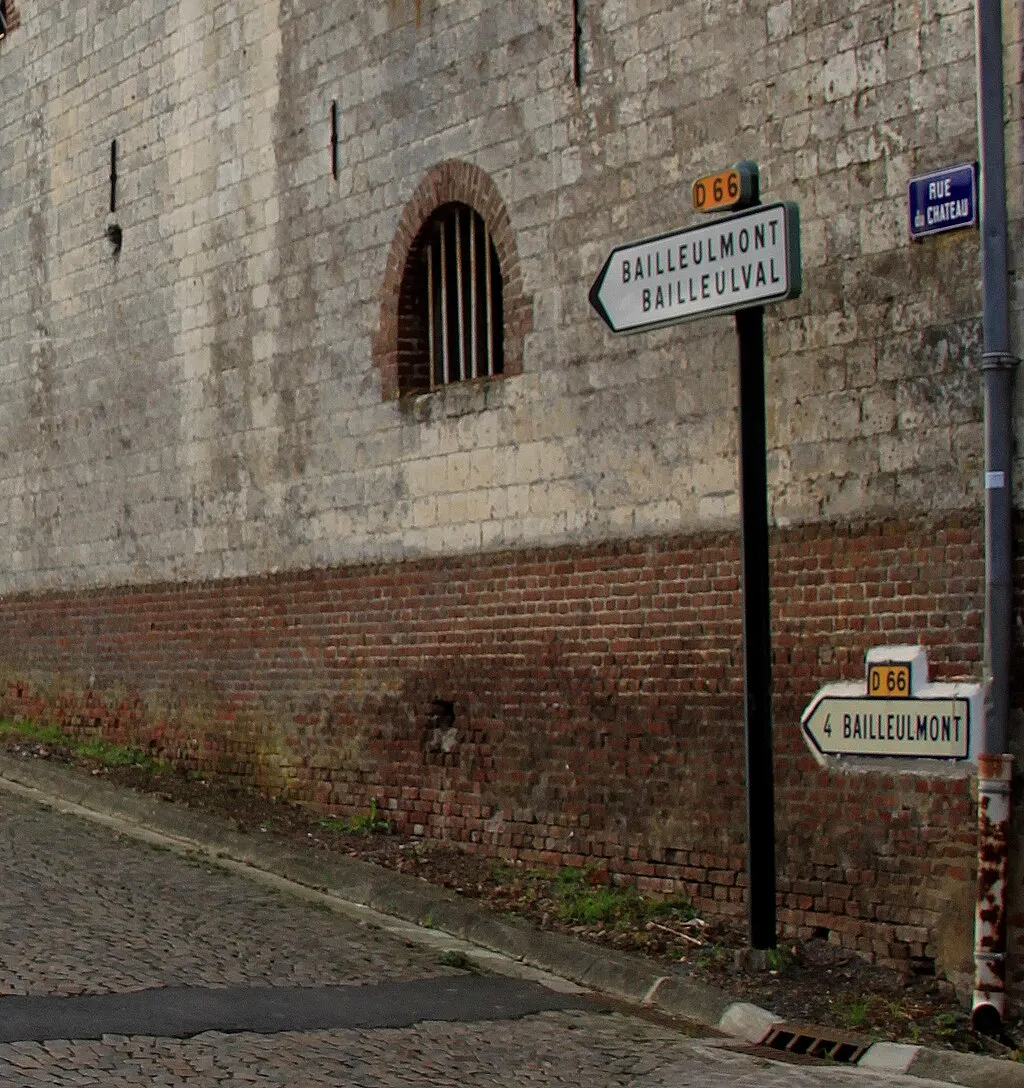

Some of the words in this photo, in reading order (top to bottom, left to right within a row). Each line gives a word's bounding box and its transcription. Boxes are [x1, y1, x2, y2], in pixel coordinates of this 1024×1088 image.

[695, 181, 706, 208] D
[713, 173, 738, 202] 66
[929, 178, 952, 200] RUE
[926, 198, 969, 225] CHATEAU
[622, 220, 779, 284] BAILLEULMONT
[642, 257, 780, 313] BAILLEULVAL
[872, 671, 881, 692] D
[887, 670, 906, 692] 66
[823, 713, 833, 739] 4
[843, 713, 962, 742] BAILLEULMONT
